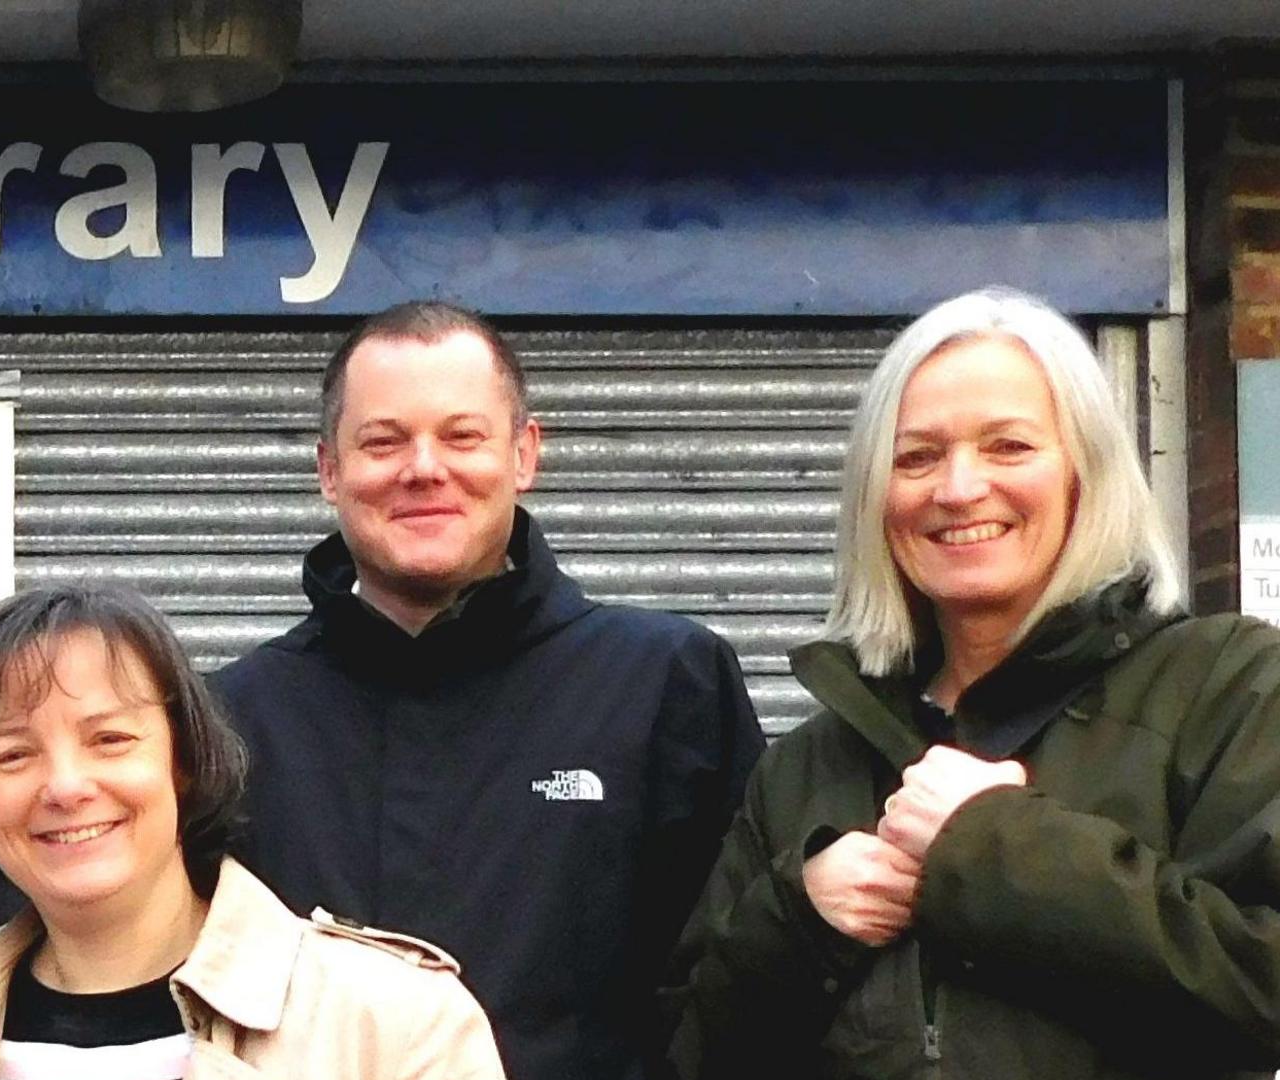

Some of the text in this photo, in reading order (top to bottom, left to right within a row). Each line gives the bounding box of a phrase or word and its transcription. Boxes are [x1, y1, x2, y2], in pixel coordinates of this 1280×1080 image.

[551, 770, 579, 781] THE
[531, 780, 579, 792] NORTH
[545, 790, 579, 801] FACE
